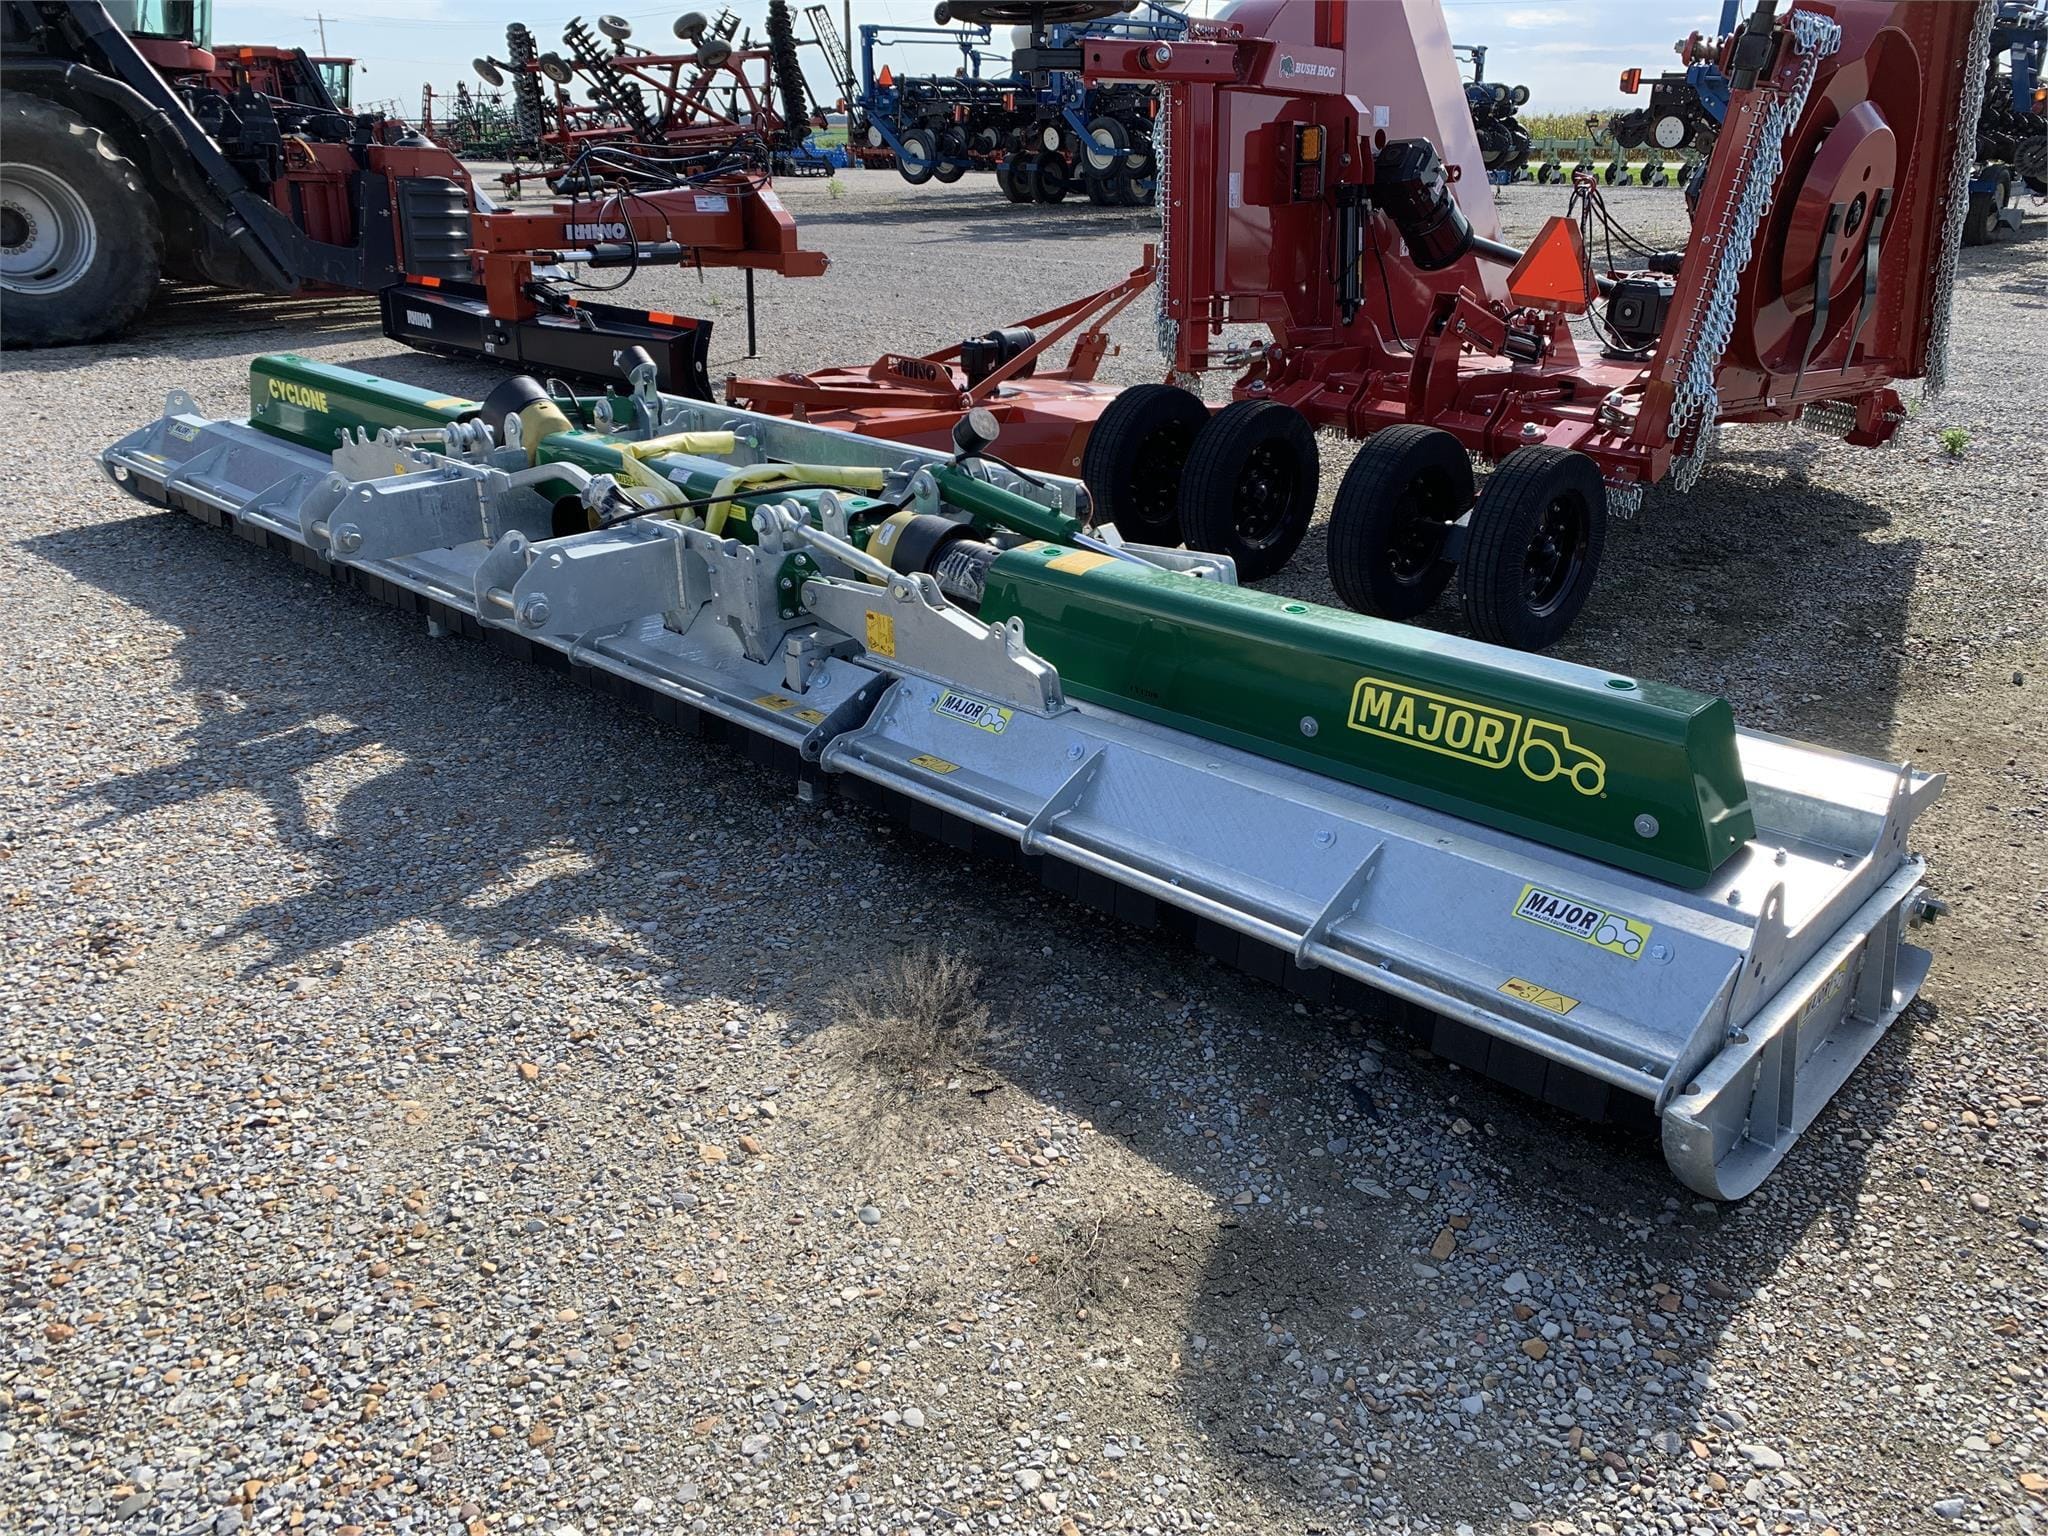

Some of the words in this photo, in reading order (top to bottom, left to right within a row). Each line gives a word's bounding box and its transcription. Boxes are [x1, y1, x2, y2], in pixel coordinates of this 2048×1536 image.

[1295, 62, 1317, 76] BUSH
[1317, 65, 1336, 78] HOG
[566, 223, 626, 240] RHINO
[406, 310, 432, 329] RHINO
[269, 378, 329, 414] CYCLONE
[942, 695, 984, 718] MAJOR
[1359, 686, 1505, 760] MAJOR
[1525, 892, 1599, 930] MAJOR
